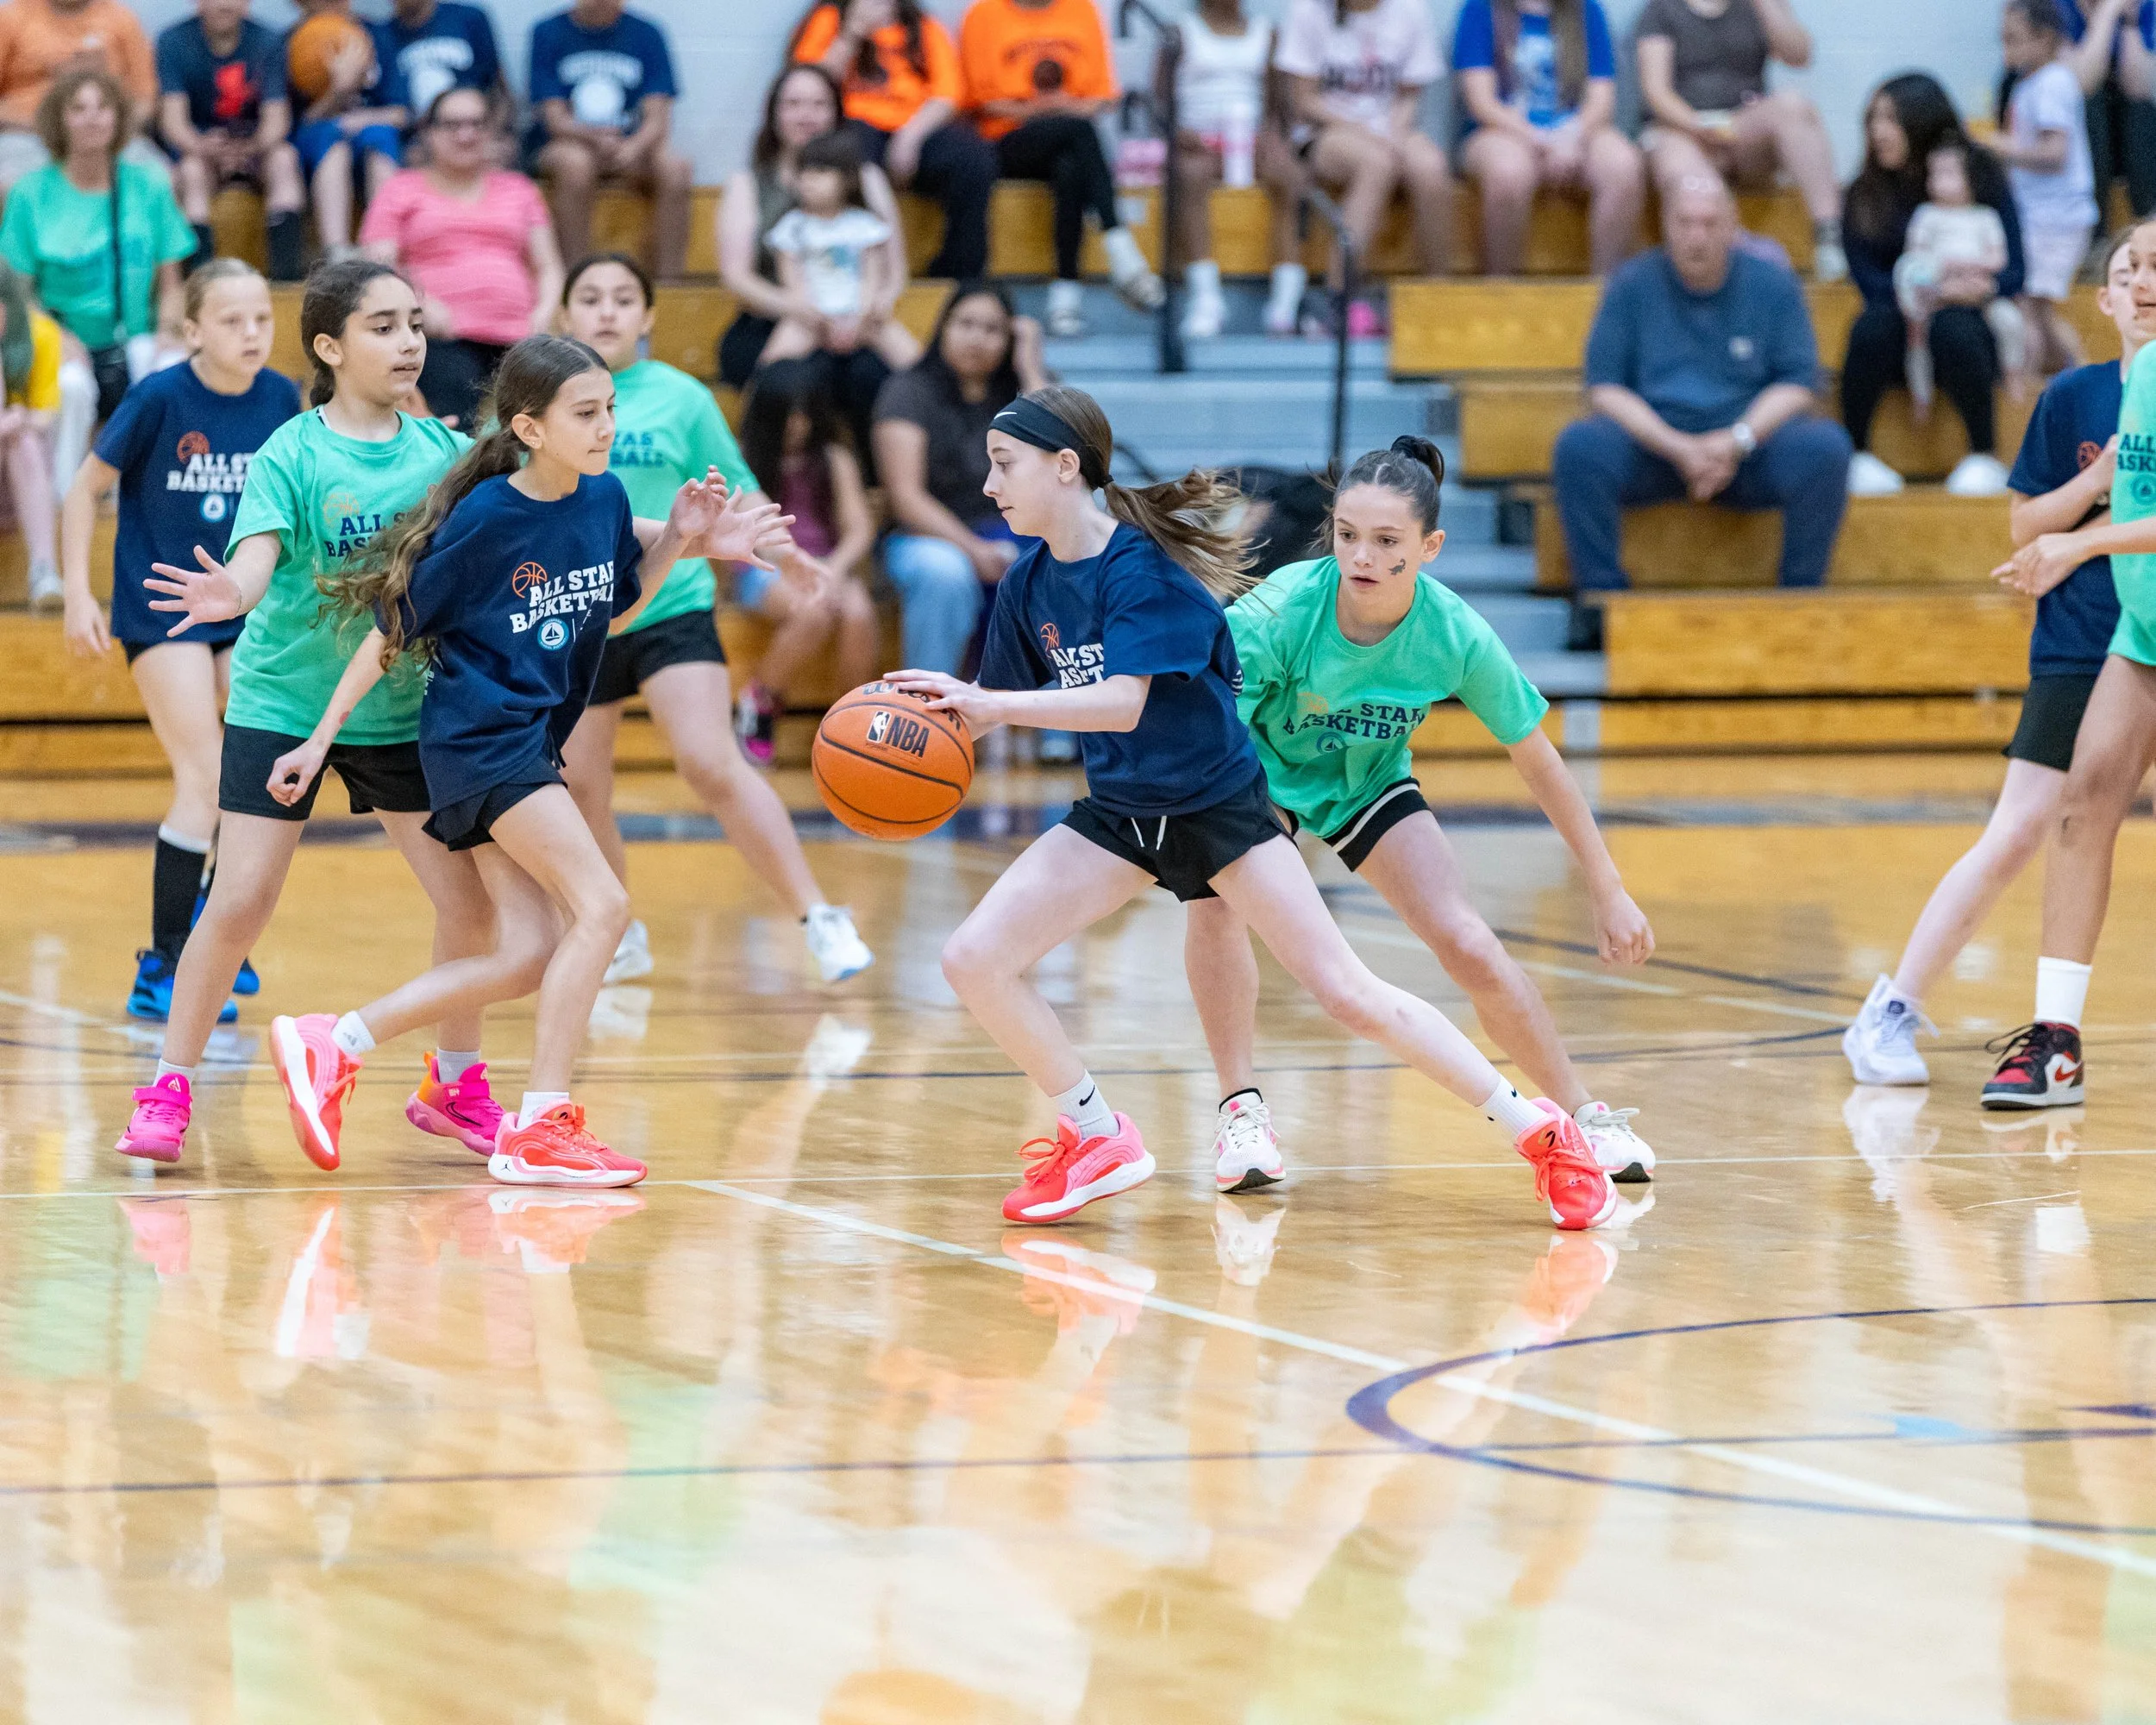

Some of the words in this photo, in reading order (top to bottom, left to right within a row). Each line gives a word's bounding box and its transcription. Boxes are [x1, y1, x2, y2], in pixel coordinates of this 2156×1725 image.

[2120, 434, 2155, 454] ALL
[185, 453, 229, 474] ALL
[530, 575, 565, 607] ALL
[886, 715, 930, 758] NBA
[1282, 714, 1415, 740] BASKETBA
